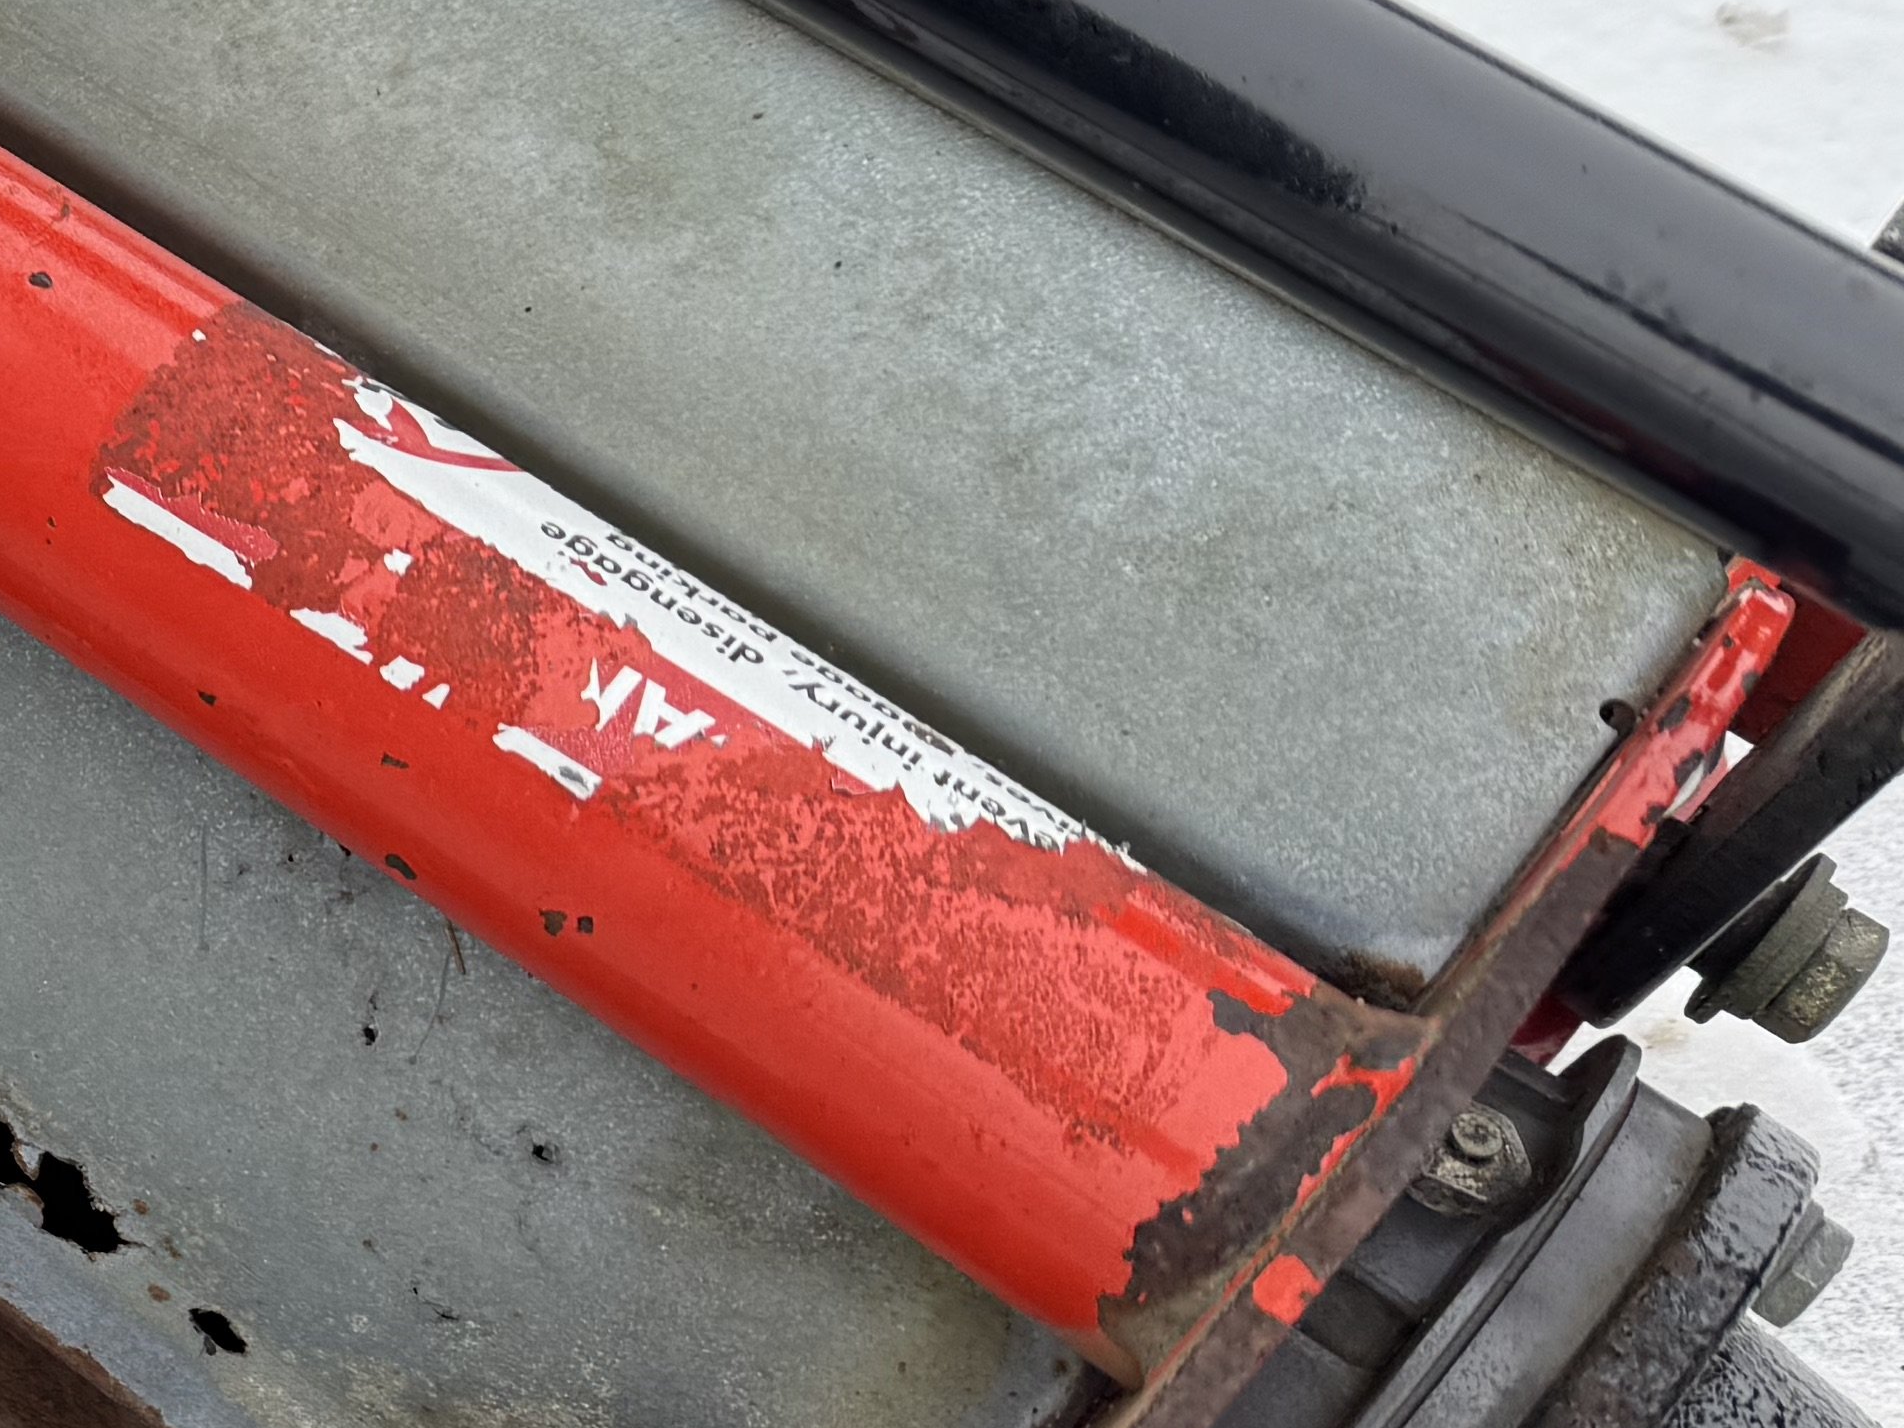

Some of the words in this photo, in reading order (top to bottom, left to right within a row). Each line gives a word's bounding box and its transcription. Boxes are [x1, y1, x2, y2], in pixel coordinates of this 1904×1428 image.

[540, 521, 765, 664] disengage
[605, 532, 778, 643] parking
[781, 669, 923, 772] injury,
